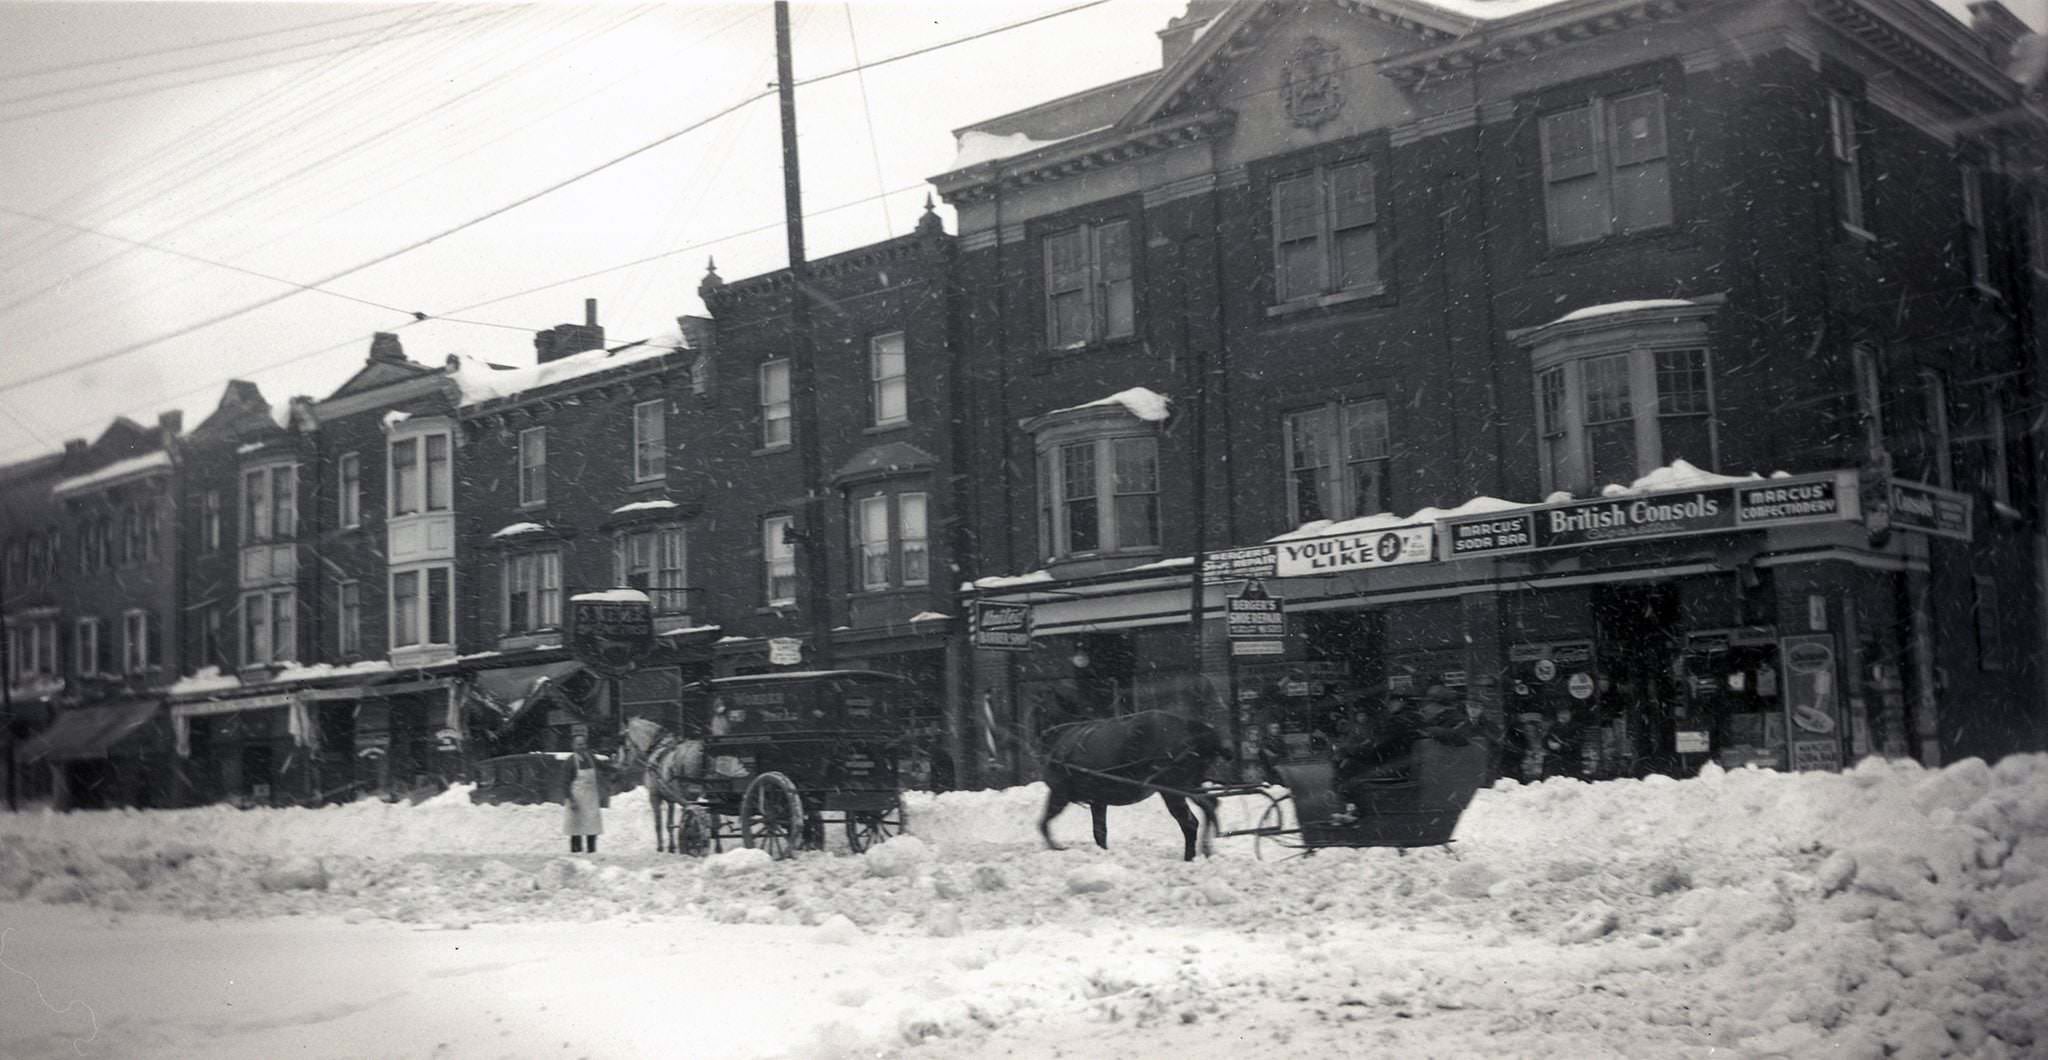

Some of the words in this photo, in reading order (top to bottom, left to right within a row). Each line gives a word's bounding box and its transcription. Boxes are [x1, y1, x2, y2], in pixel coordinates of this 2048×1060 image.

[1751, 483, 1828, 504] MARCUS'
[1551, 504, 1626, 533] British
[1630, 494, 1719, 524] Consols
[1742, 500, 1836, 519] CONFECTIONERY
[1460, 518, 1524, 537] MARCUS'
[1285, 537, 1369, 561] YOU'LL
[1456, 536, 1492, 550] SODA
[1499, 533, 1528, 545] BAR
[1233, 555, 1276, 569] REPAIR
[1312, 547, 1375, 569] LIKE
